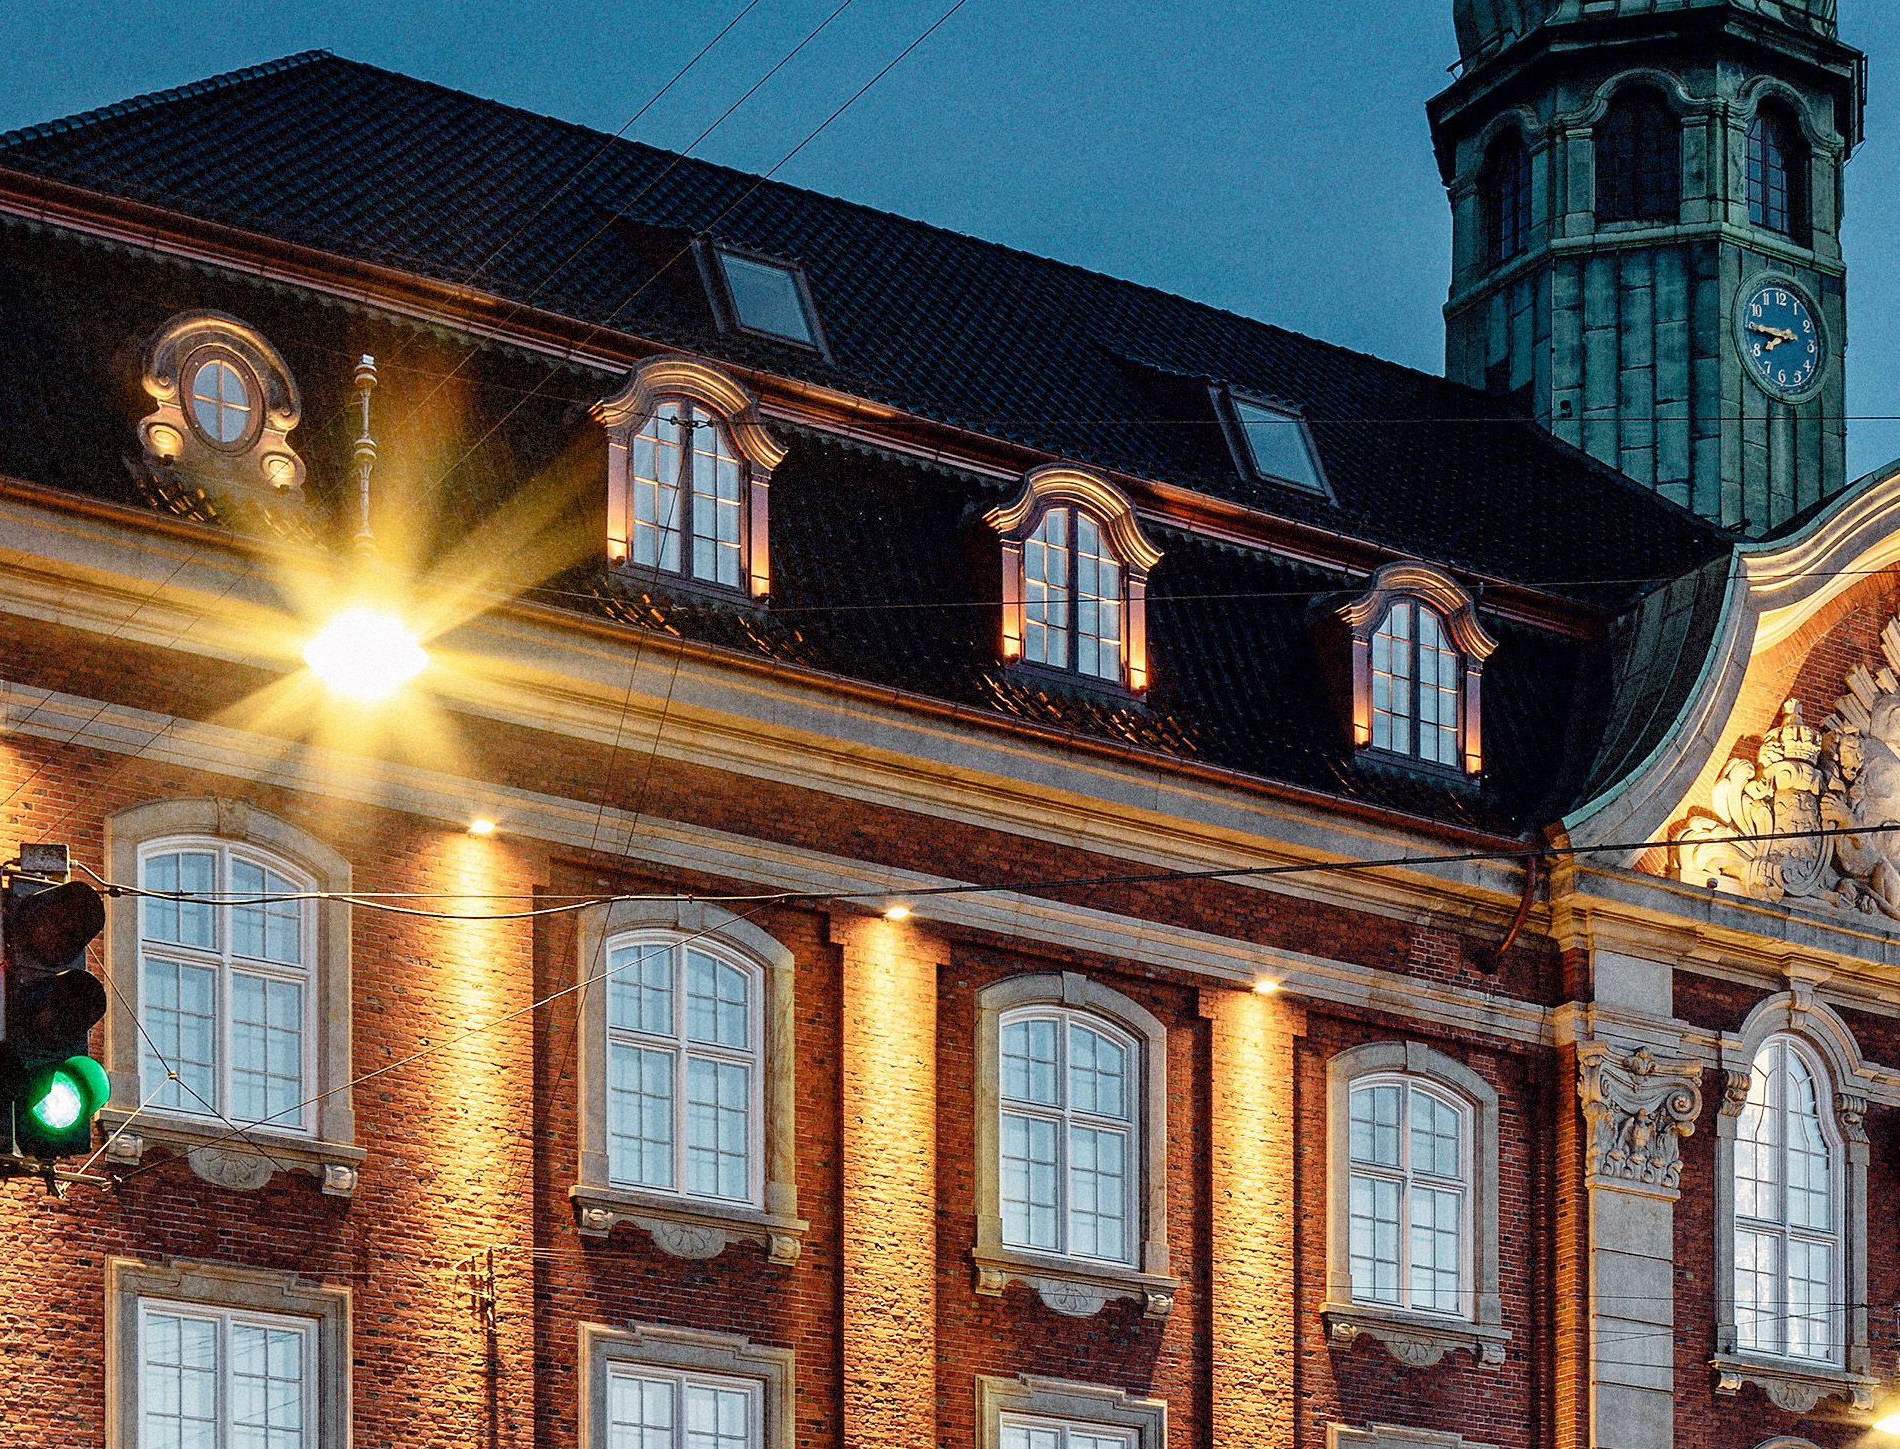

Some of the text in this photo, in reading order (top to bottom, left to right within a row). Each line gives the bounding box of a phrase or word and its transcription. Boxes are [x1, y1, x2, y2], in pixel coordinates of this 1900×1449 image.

[1763, 293, 1770, 305] 11
[1776, 292, 1787, 306] 12
[1751, 303, 1762, 317] 10
[1793, 302, 1798, 315] 1
[1803, 319, 1810, 333] 2
[1753, 343, 1761, 357] 8
[1807, 339, 1815, 353] 3
[1764, 360, 1772, 374] 7
[1803, 359, 1811, 372] 4
[1778, 369, 1786, 383] 6
[1793, 370, 1802, 383] 5
